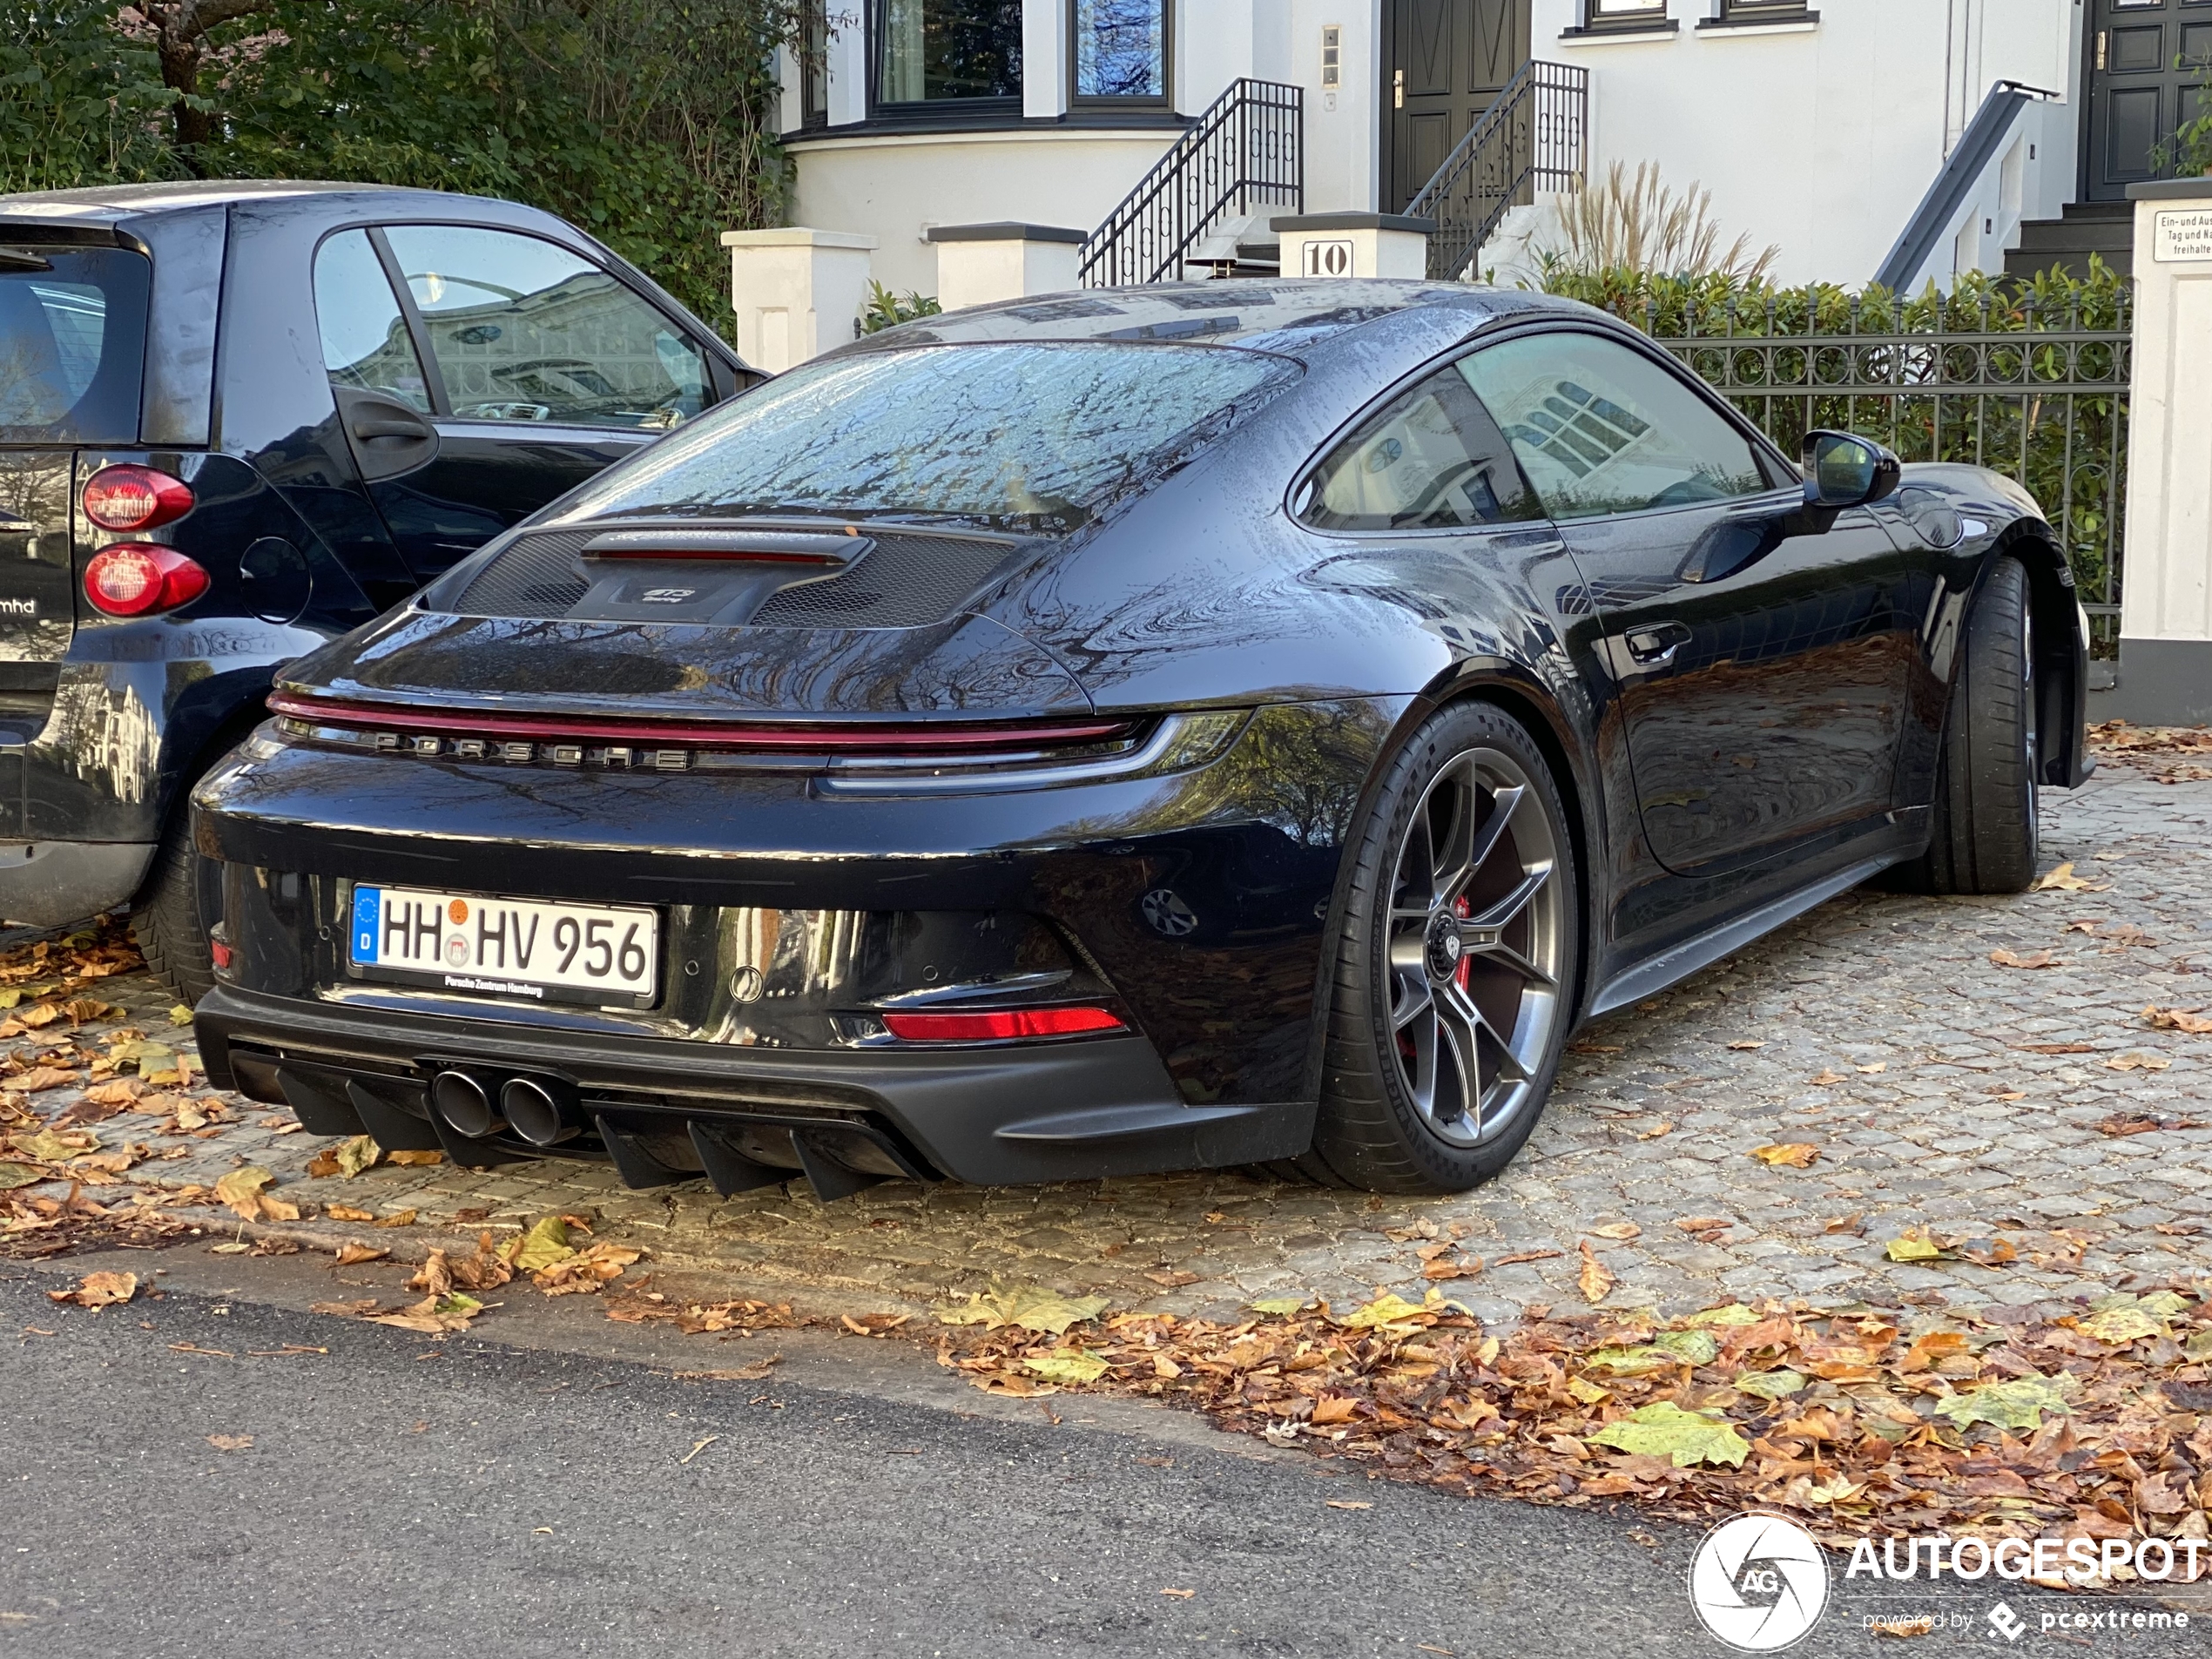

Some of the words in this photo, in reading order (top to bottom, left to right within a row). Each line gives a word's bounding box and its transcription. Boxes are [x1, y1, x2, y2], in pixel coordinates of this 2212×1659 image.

[2161, 217, 2179, 226] Ein-
[2181, 216, 2196, 226] und
[2168, 231, 2182, 242] Tag
[2185, 230, 2201, 239] und
[1307, 244, 1347, 275] 10
[0, 599, 35, 613] mhd
[374, 733, 688, 770] PORSCHE
[361, 933, 371, 950] D
[382, 900, 442, 961] HH
[476, 907, 540, 970] HV
[553, 916, 646, 981] 956
[445, 975, 475, 988] Porsche
[475, 979, 507, 992] Zentrum
[507, 982, 543, 998] Hamburg
